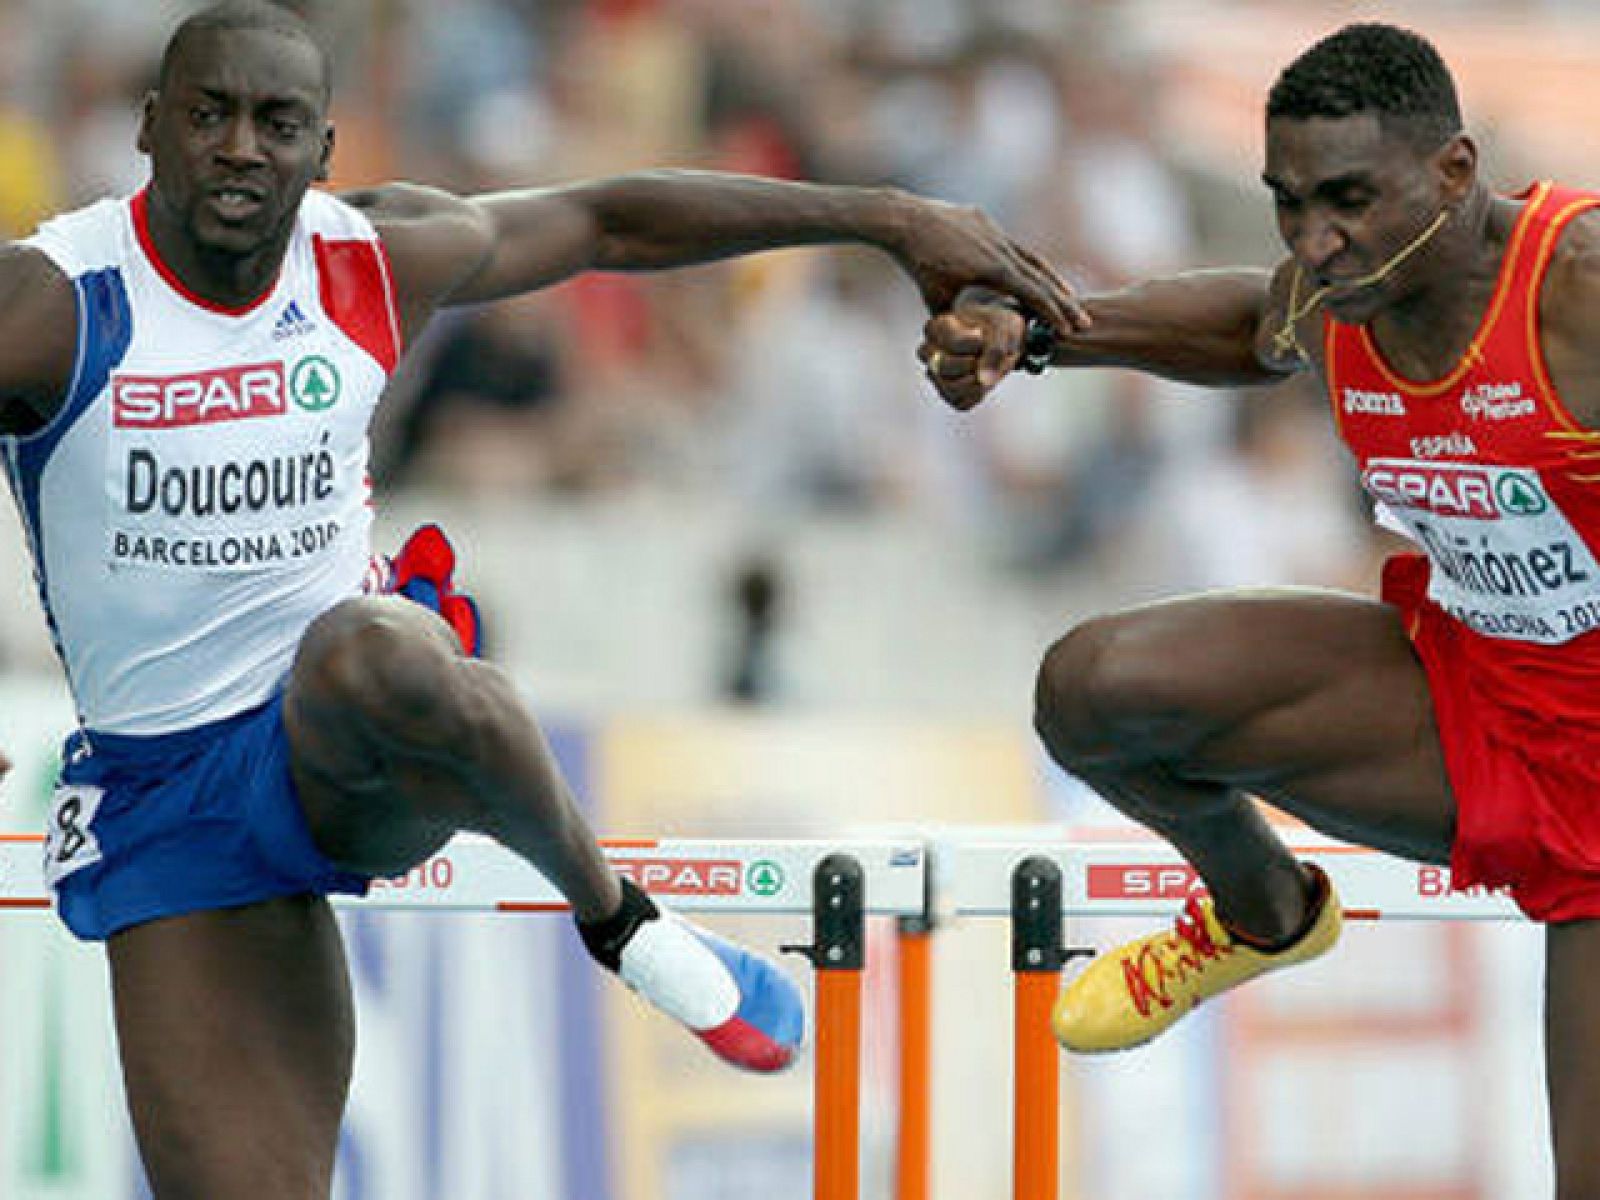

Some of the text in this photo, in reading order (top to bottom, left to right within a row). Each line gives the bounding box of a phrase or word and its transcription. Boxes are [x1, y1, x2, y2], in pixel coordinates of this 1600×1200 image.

[119, 369, 282, 420] SPAR
[126, 430, 334, 517] Doucouré
[1367, 471, 1494, 514] SPAR
[114, 532, 284, 566] BARCELONA
[57, 795, 86, 862] 8
[369, 856, 454, 889] 10
